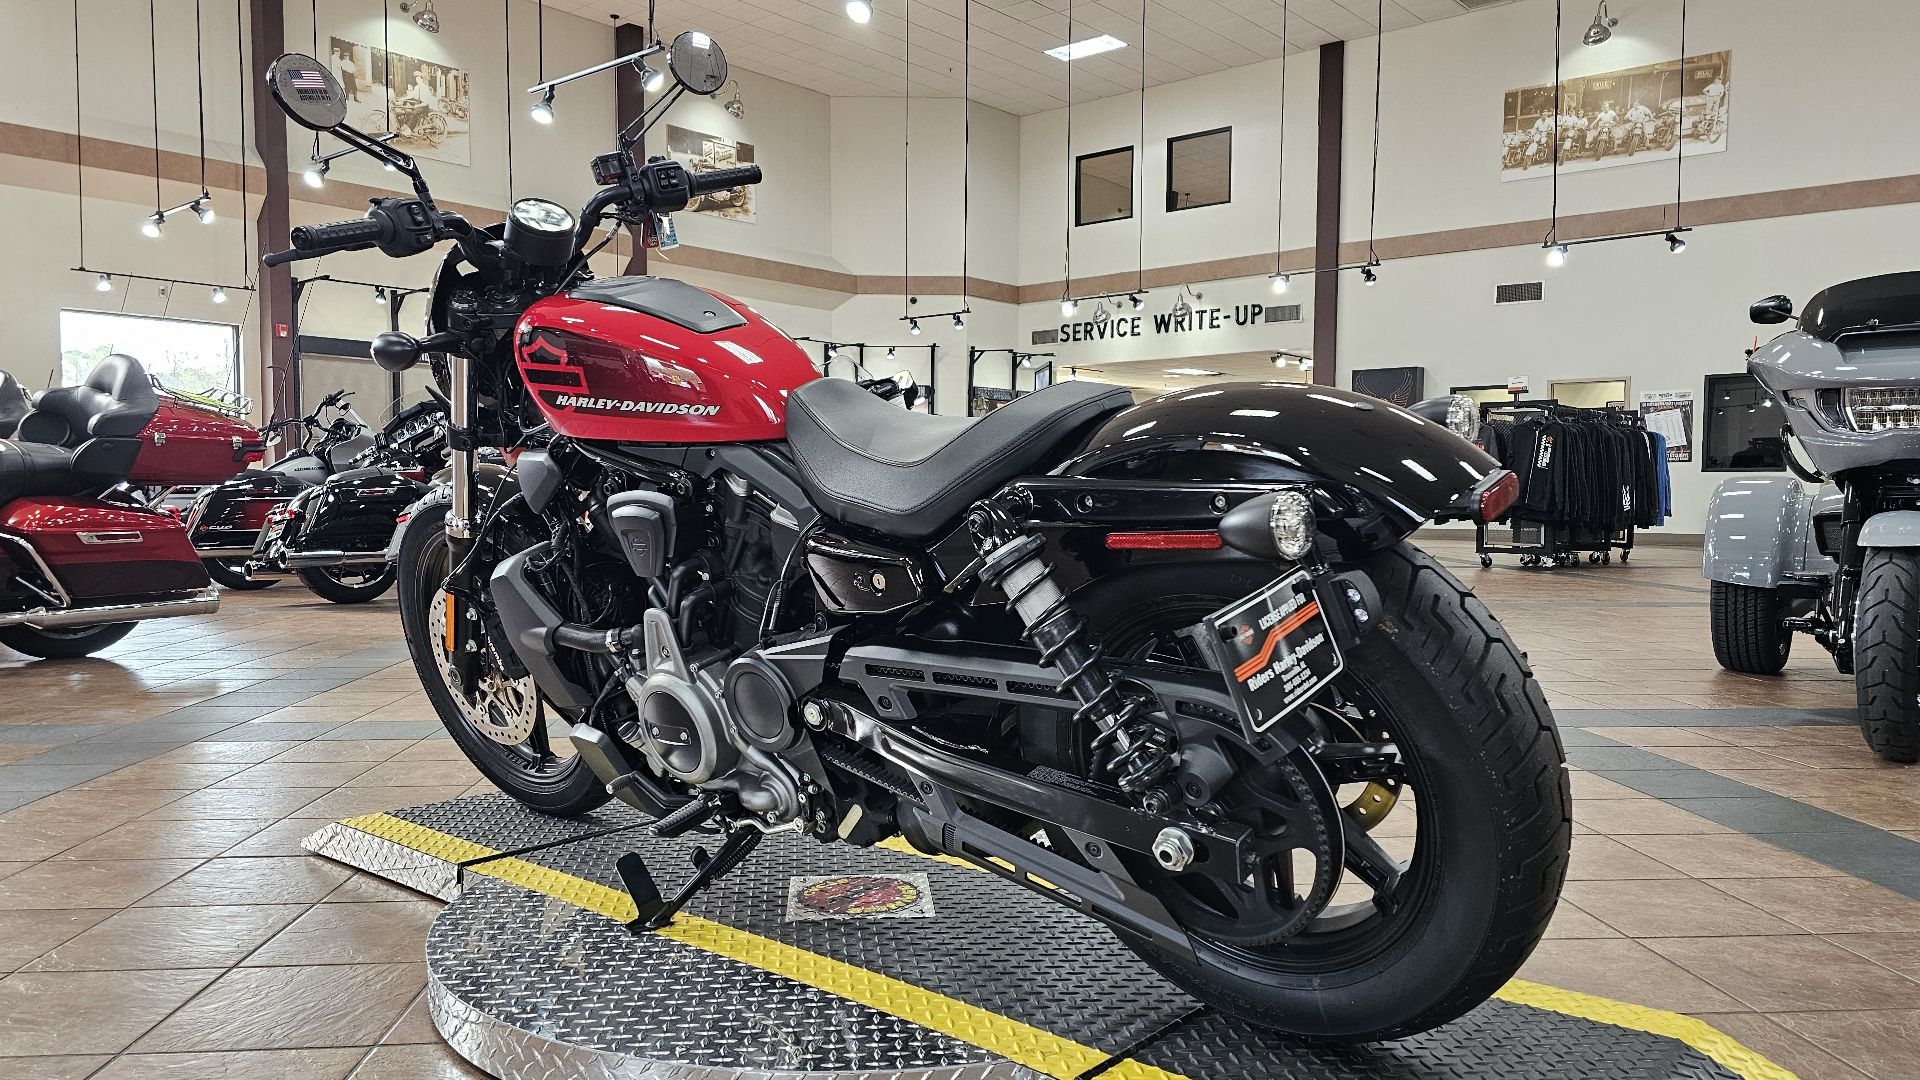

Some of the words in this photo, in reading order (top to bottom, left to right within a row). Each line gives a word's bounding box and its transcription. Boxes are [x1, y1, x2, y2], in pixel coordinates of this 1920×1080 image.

[1060, 316, 1142, 343] SERVICE
[1154, 303, 1263, 334] WRITE-UP
[556, 394, 721, 417] HARLEY-DAVIDSON
[1247, 669, 1275, 692] Riders
[1272, 633, 1325, 675] Harley-Davidson
